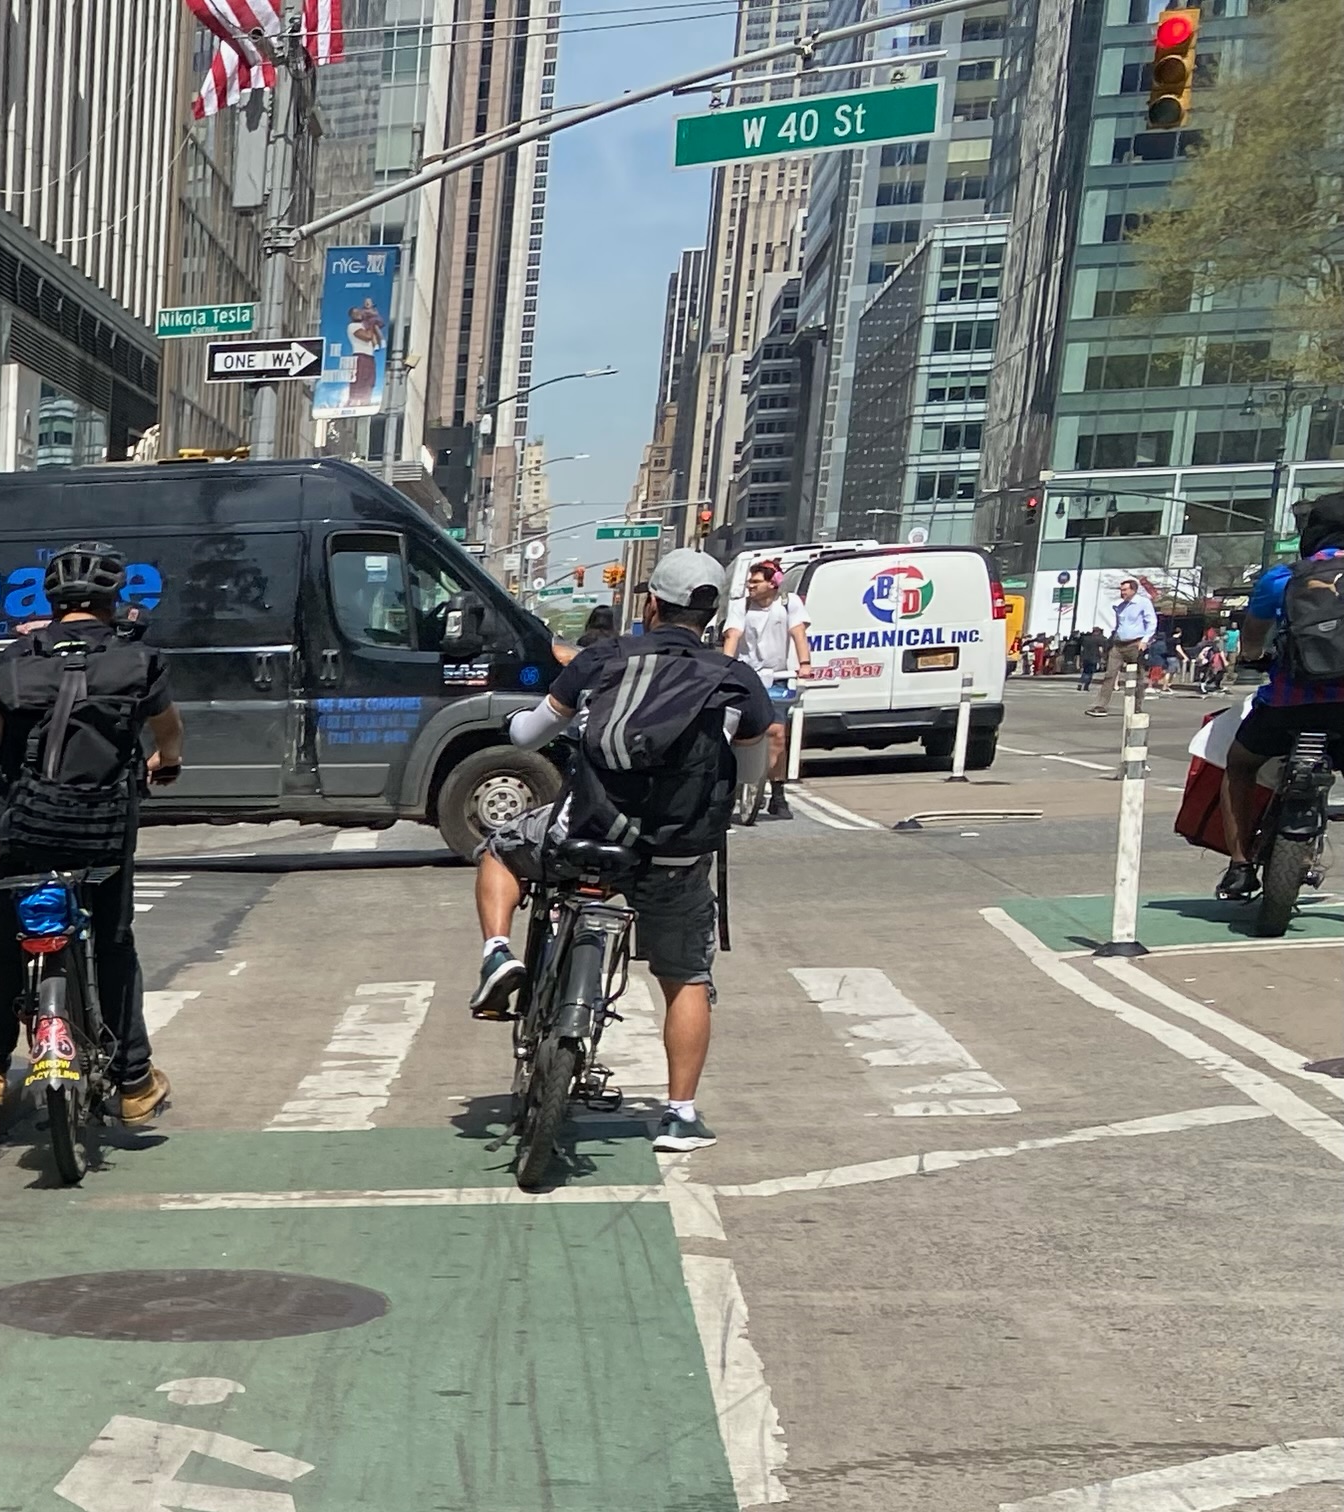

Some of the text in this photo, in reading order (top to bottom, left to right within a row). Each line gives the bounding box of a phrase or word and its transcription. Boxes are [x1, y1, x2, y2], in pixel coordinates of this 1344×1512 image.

[742, 103, 867, 149] W 40 St
[160, 307, 251, 328] Nikola Tesla
[223, 351, 306, 370] ONE WAY
[806, 627, 946, 652] MECHANICAL
[32, 1058, 71, 1072] ARROW
